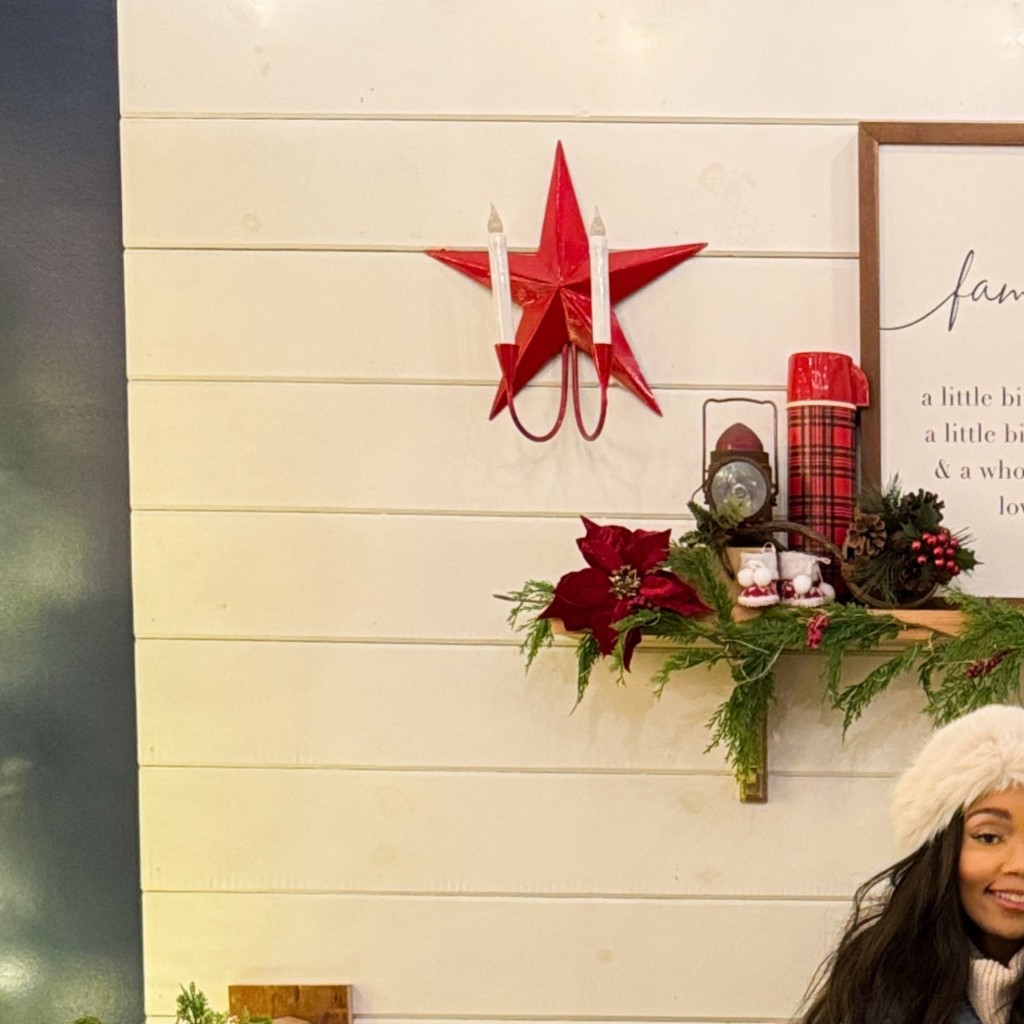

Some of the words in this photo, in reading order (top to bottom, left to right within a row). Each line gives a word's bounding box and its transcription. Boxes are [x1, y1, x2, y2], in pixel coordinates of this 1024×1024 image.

[921, 392, 933, 407] a
[941, 386, 993, 407] little
[924, 429, 936, 443] a
[944, 422, 996, 443] little
[934, 458, 951, 480] &
[960, 466, 971, 480] a
